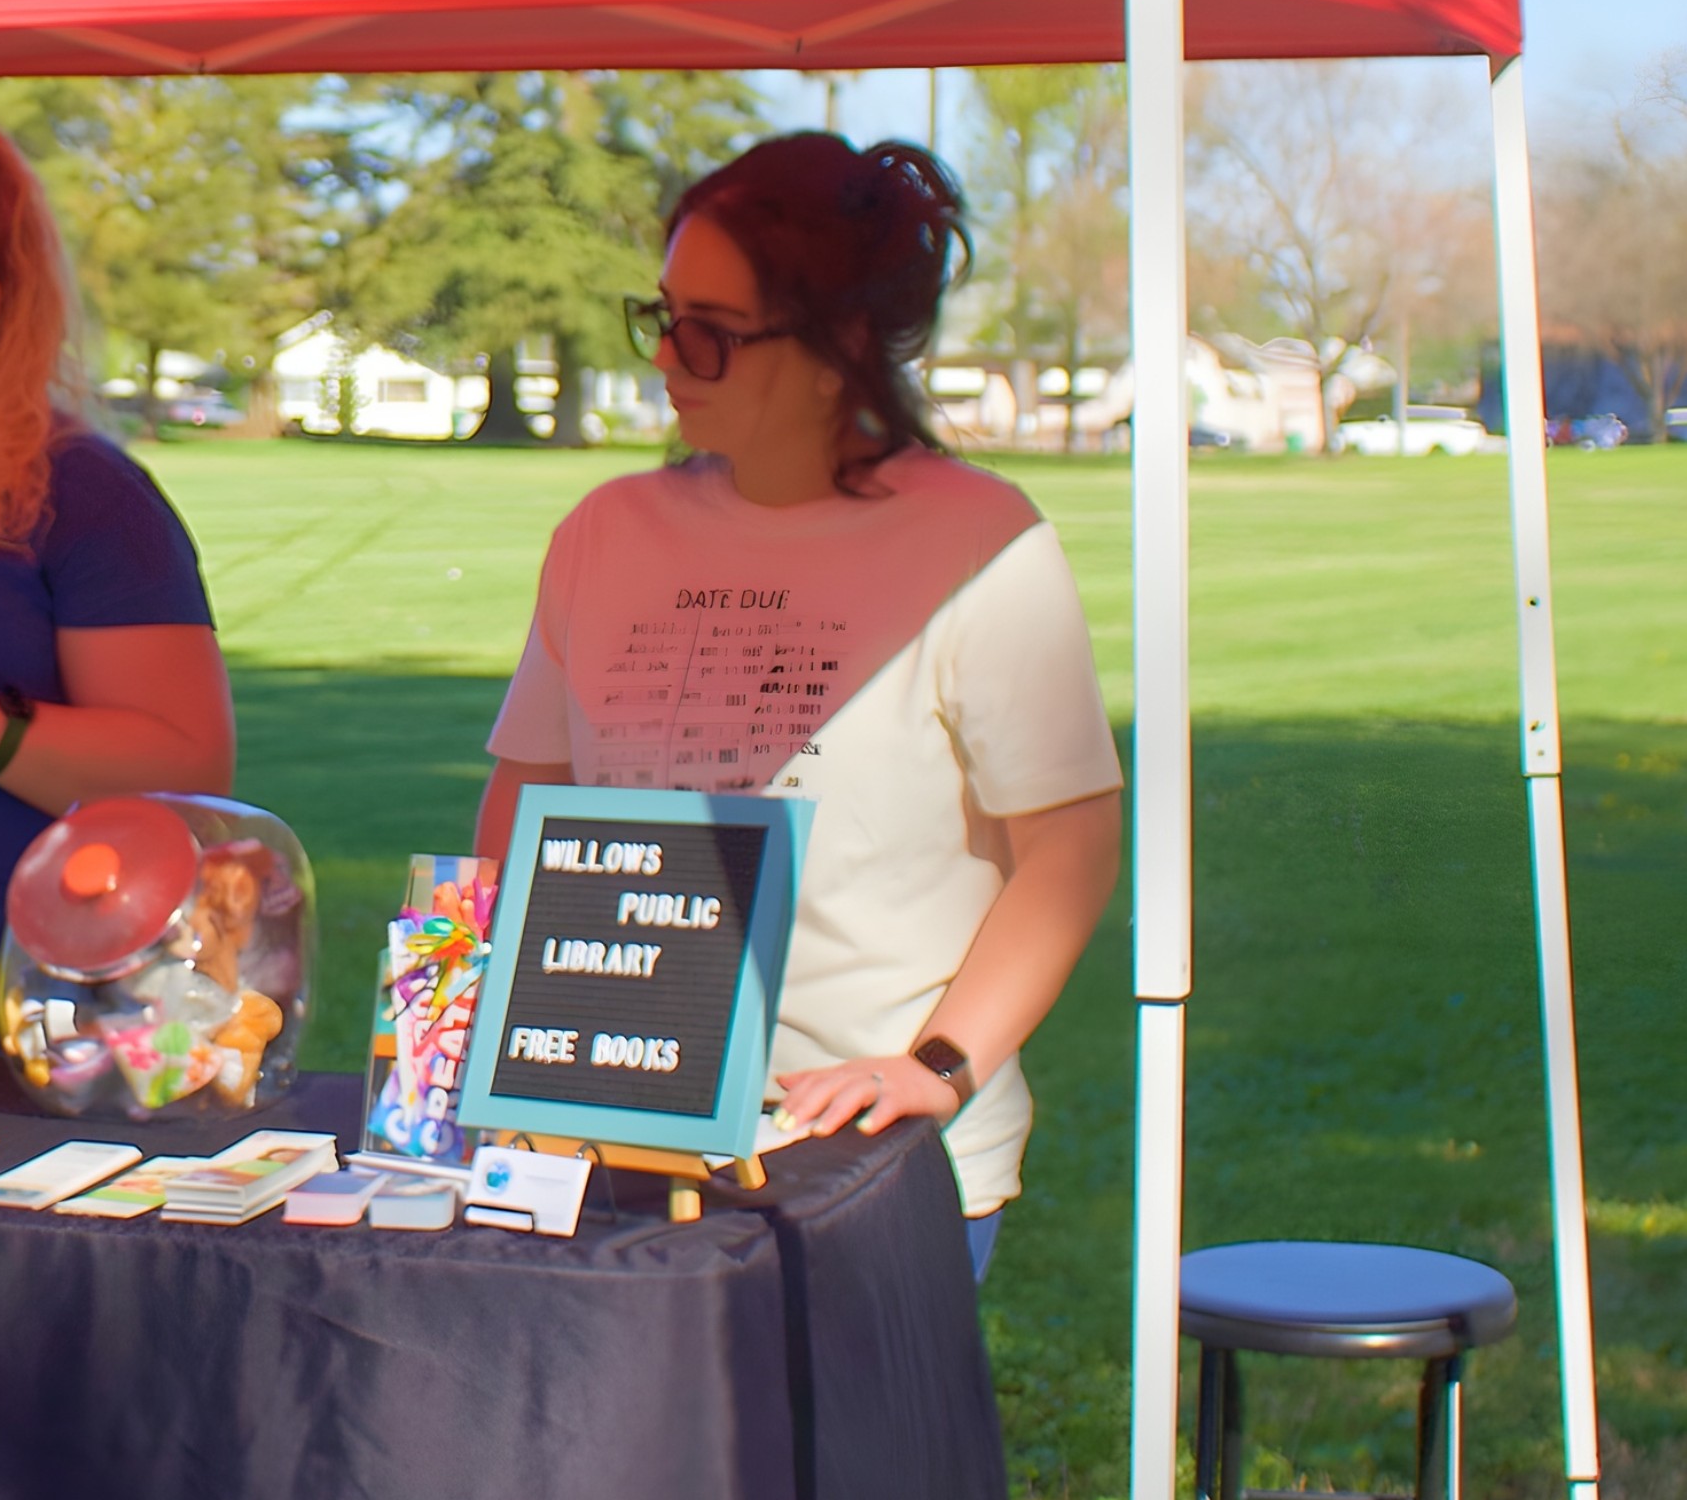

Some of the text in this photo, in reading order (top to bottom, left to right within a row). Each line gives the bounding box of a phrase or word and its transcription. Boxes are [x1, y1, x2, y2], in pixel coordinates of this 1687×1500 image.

[676, 588, 790, 609] DATE DUE
[616, 891, 722, 931] PUBLIC
[541, 937, 662, 979] LIBRARY
[507, 1026, 681, 1073] FREE BOOKS
